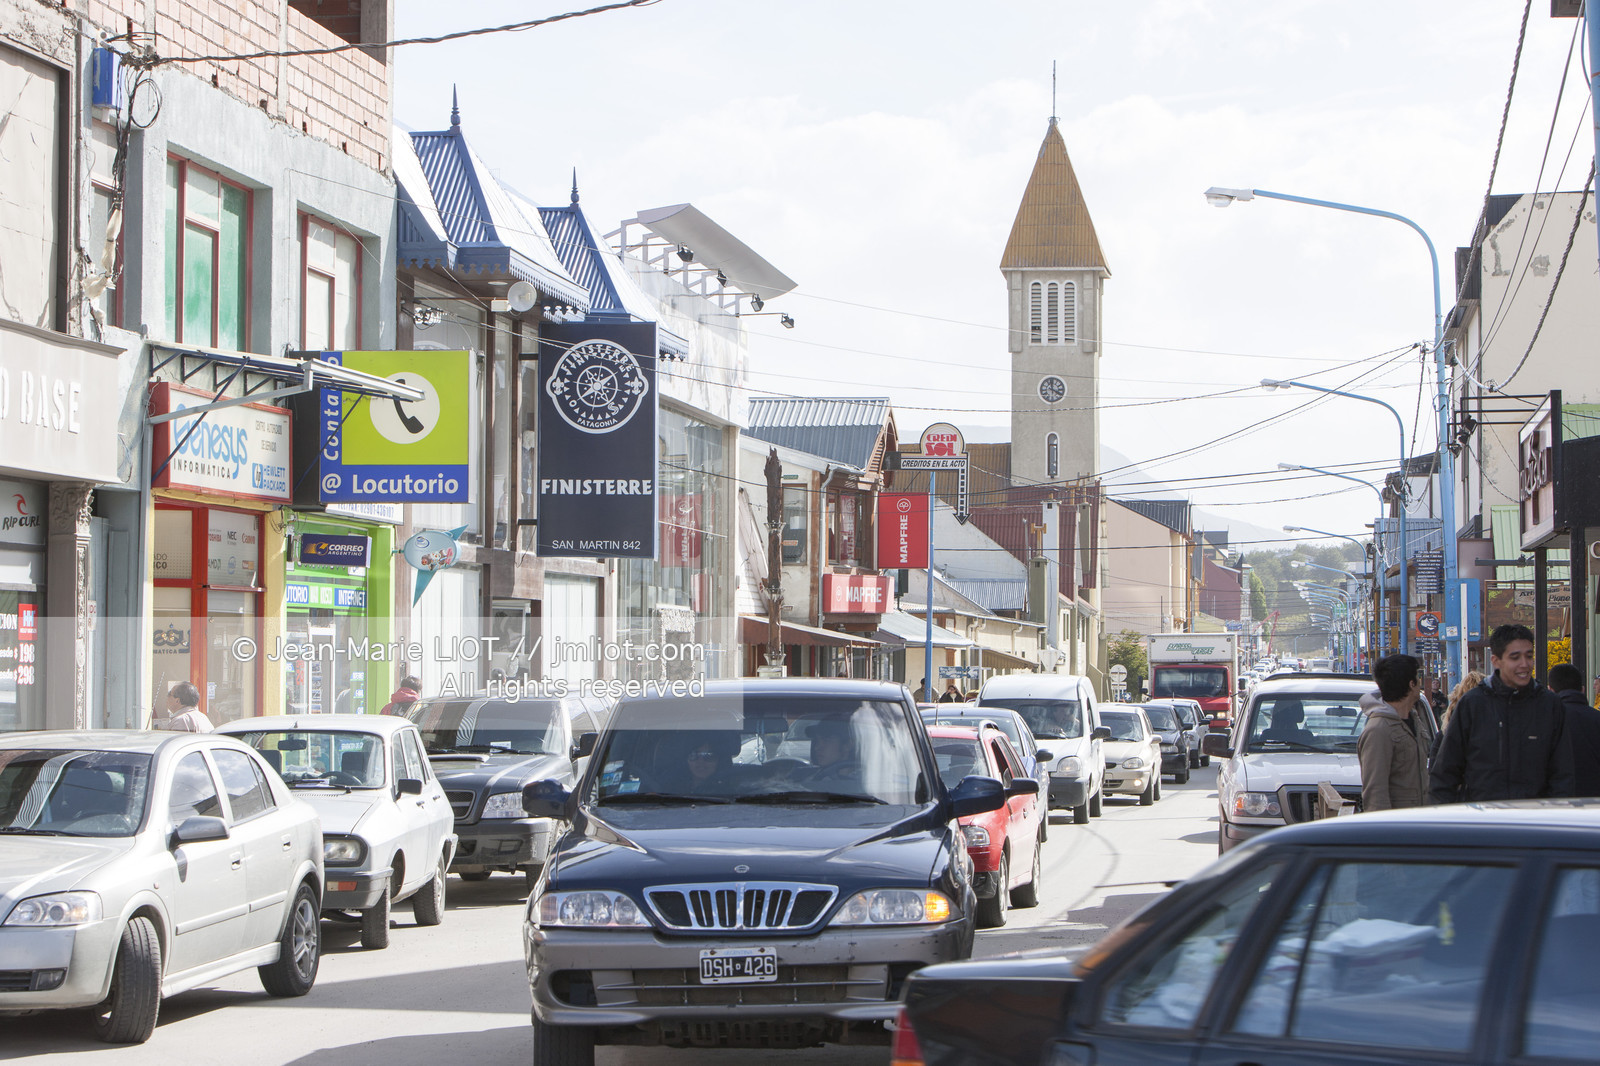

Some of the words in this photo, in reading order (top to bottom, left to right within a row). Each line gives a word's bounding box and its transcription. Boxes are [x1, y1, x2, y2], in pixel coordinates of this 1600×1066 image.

[560, 344, 635, 374] FINISTERRE
[20, 370, 81, 434] BASE
[576, 417, 619, 428] PATAGONIA
[926, 434, 958, 442] CREDI
[925, 442, 957, 457] SOL
[173, 457, 231, 479] INFORMATICA
[902, 459, 931, 468] CREDITOS
[932, 460, 941, 468] EN
[941, 460, 949, 468] EL
[949, 460, 966, 468] ACTO
[352, 472, 459, 494] Locutorio
[541, 479, 653, 496] FINISTERRE
[3, 516, 18, 531] RIP
[19, 515, 41, 528] CURL
[227, 531, 237, 541] NEC
[899, 514, 909, 564] MAPFRE
[328, 544, 364, 552] CORREO
[551, 540, 574, 549] SAN
[579, 540, 621, 550] MARTIN
[622, 540, 641, 550] 842
[338, 589, 365, 606] INTERNET
[846, 587, 882, 603] MAPFRE
[19, 643, 35, 663] 198
[17, 665, 35, 685] 298
[703, 958, 733, 978] DSH
[744, 956, 774, 976] 426
